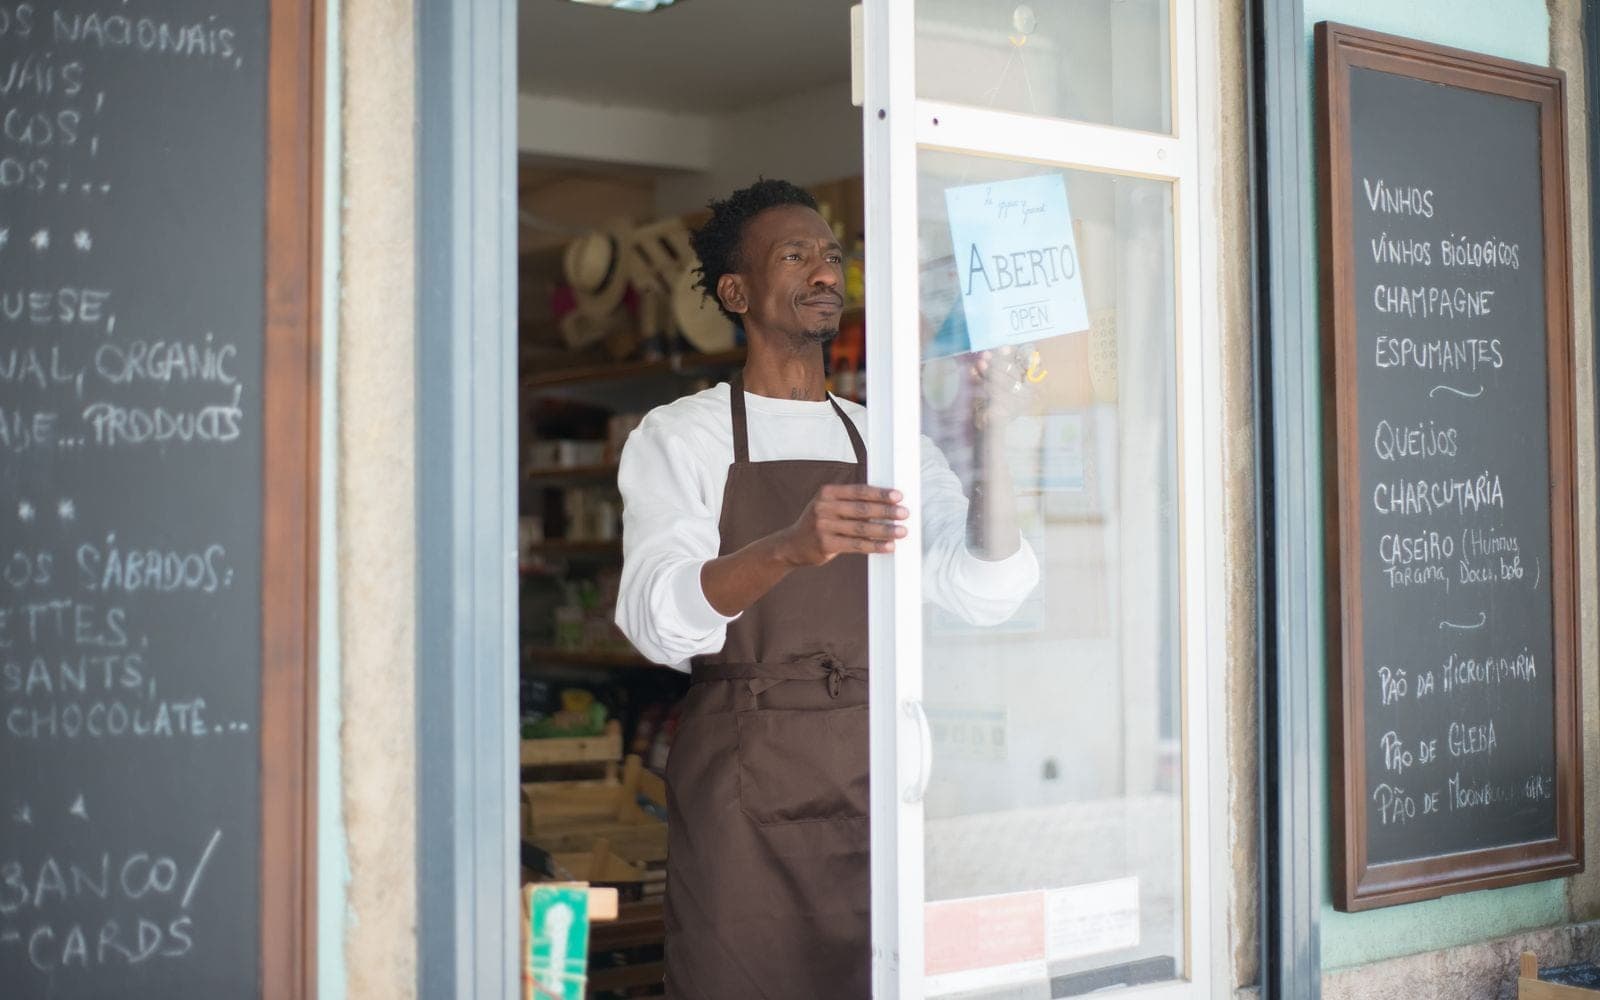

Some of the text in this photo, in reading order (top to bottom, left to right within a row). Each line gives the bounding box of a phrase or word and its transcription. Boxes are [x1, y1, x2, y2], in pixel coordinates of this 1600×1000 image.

[1363, 177, 1434, 218] VINHOS
[1371, 231, 1432, 267] VINHOS
[966, 242, 1076, 296] ABERTO
[1010, 304, 1050, 332] OPEN
[1374, 284, 1495, 319] CHAMPAGNE
[1375, 335, 1503, 373] ESPUMANTES
[82, 403, 243, 446] PRODUCTS
[1374, 419, 1458, 461] QUEIJOS
[1374, 470, 1504, 515] CHARCUTARIA
[1379, 529, 1454, 565] CASEIRO
[1416, 670, 1434, 699] DA
[1420, 739, 1438, 764] DE
[1448, 720, 1497, 757] GLEBA
[1423, 791, 1440, 814] DE
